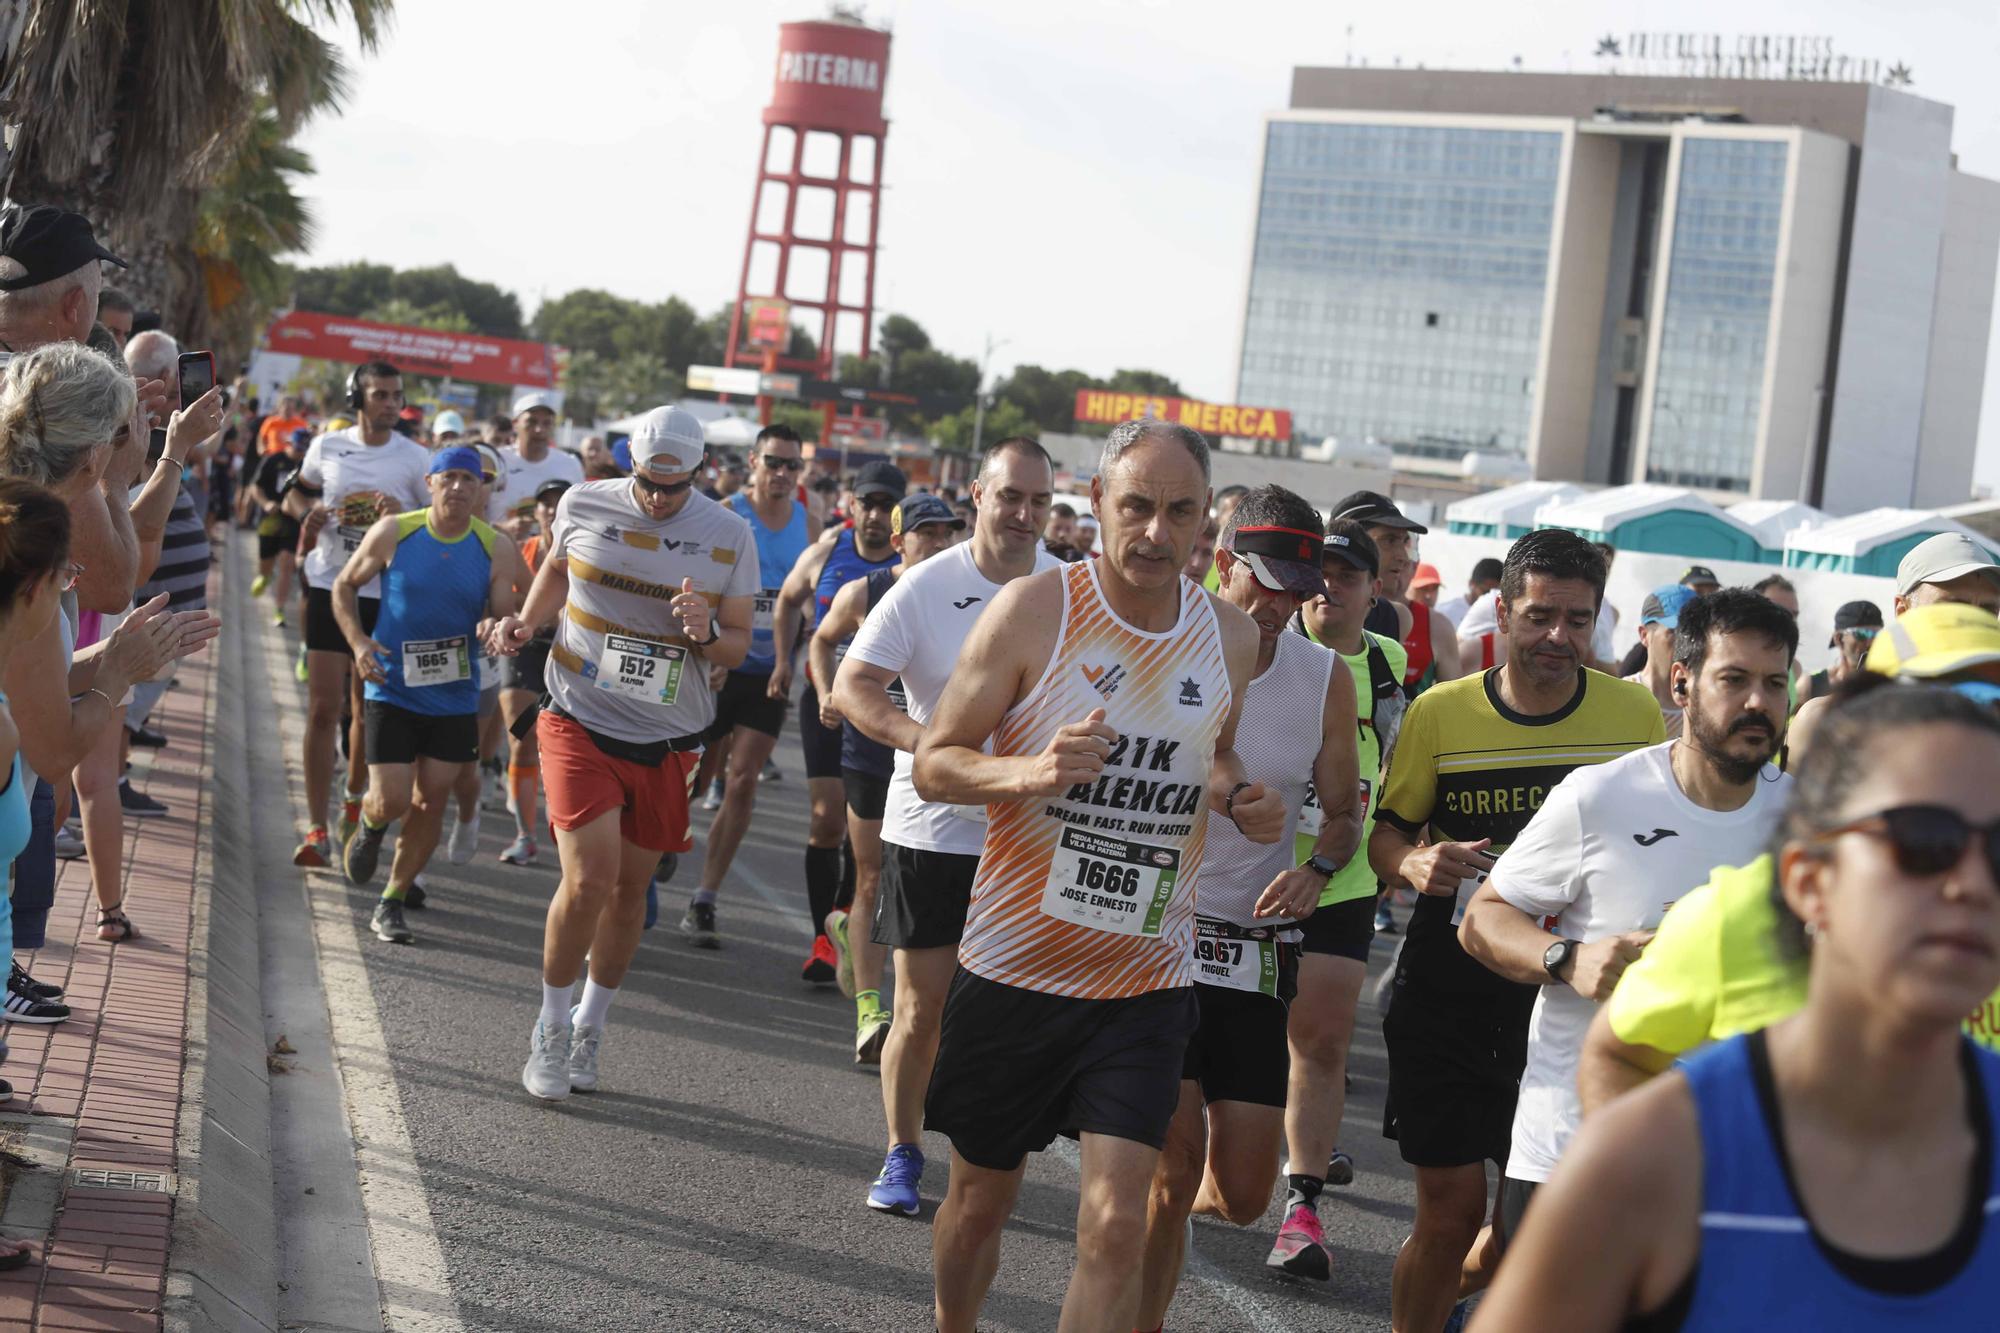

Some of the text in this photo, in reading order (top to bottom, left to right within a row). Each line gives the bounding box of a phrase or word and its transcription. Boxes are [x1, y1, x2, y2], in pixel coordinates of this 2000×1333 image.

[781, 50, 879, 91] PATERNA
[1085, 392, 1278, 438] HIPER MERCA
[600, 573, 674, 602] MARATÓN
[416, 652, 448, 669] 1665
[619, 654, 656, 678] 1512
[620, 676, 645, 687] RAMON
[1103, 733, 1180, 772] 21K
[1064, 775, 1202, 816] ALENCIA
[1446, 785, 1557, 815] CORREC
[1045, 805, 1192, 836] DREAM FAST. RUN FASTER
[1069, 839, 1127, 859] VILA DE PATERNA
[1070, 832, 1128, 852] MEDIA MARATÓN
[1075, 857, 1141, 897] 1666
[1158, 881, 1171, 900] BOX
[1060, 887, 1138, 914] JOSE ERNESTO
[1201, 963, 1230, 978] MIGUEL
[1264, 951, 1273, 967] BOX
